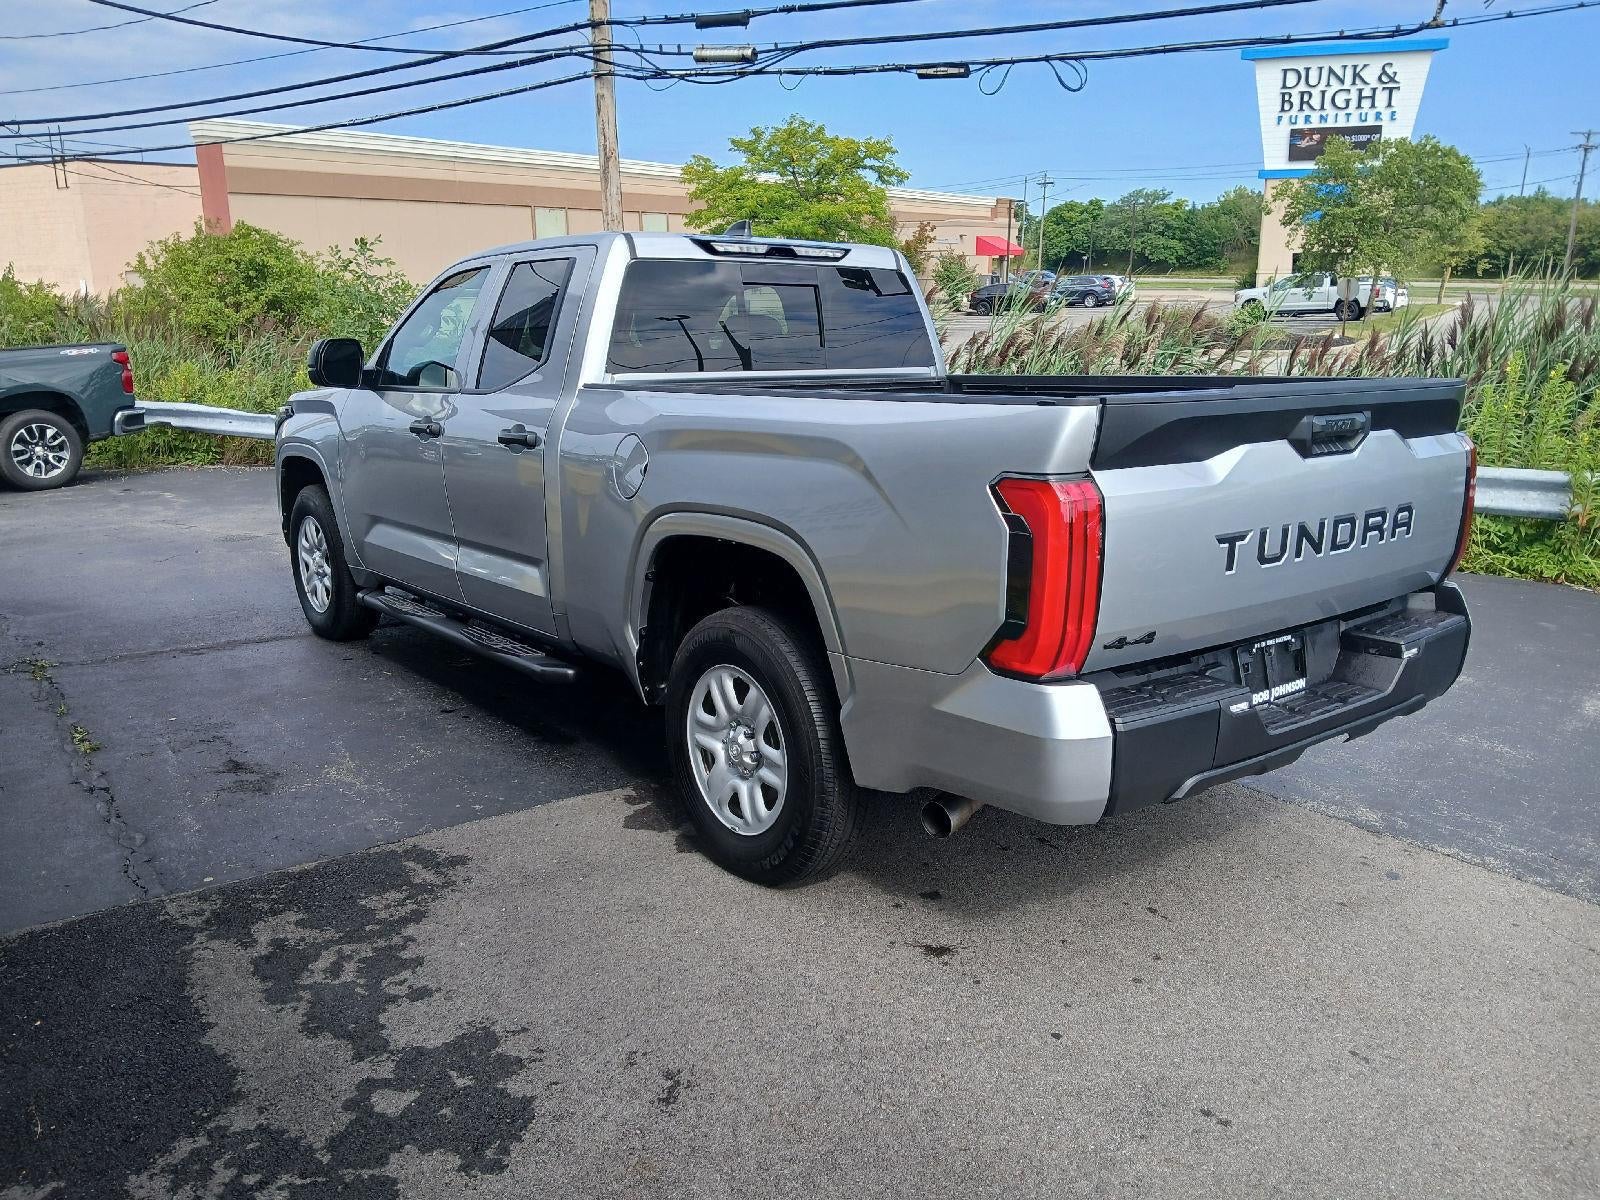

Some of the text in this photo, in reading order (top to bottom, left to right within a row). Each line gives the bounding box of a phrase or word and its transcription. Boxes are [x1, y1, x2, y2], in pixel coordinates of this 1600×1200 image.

[1281, 62, 1400, 89] DUNK &
[1279, 86, 1400, 112] BRIGHT
[1277, 110, 1398, 125] FURNITURE
[1214, 501, 1416, 575] TUNDRA
[1252, 678, 1306, 705] BOB JOHNSON
